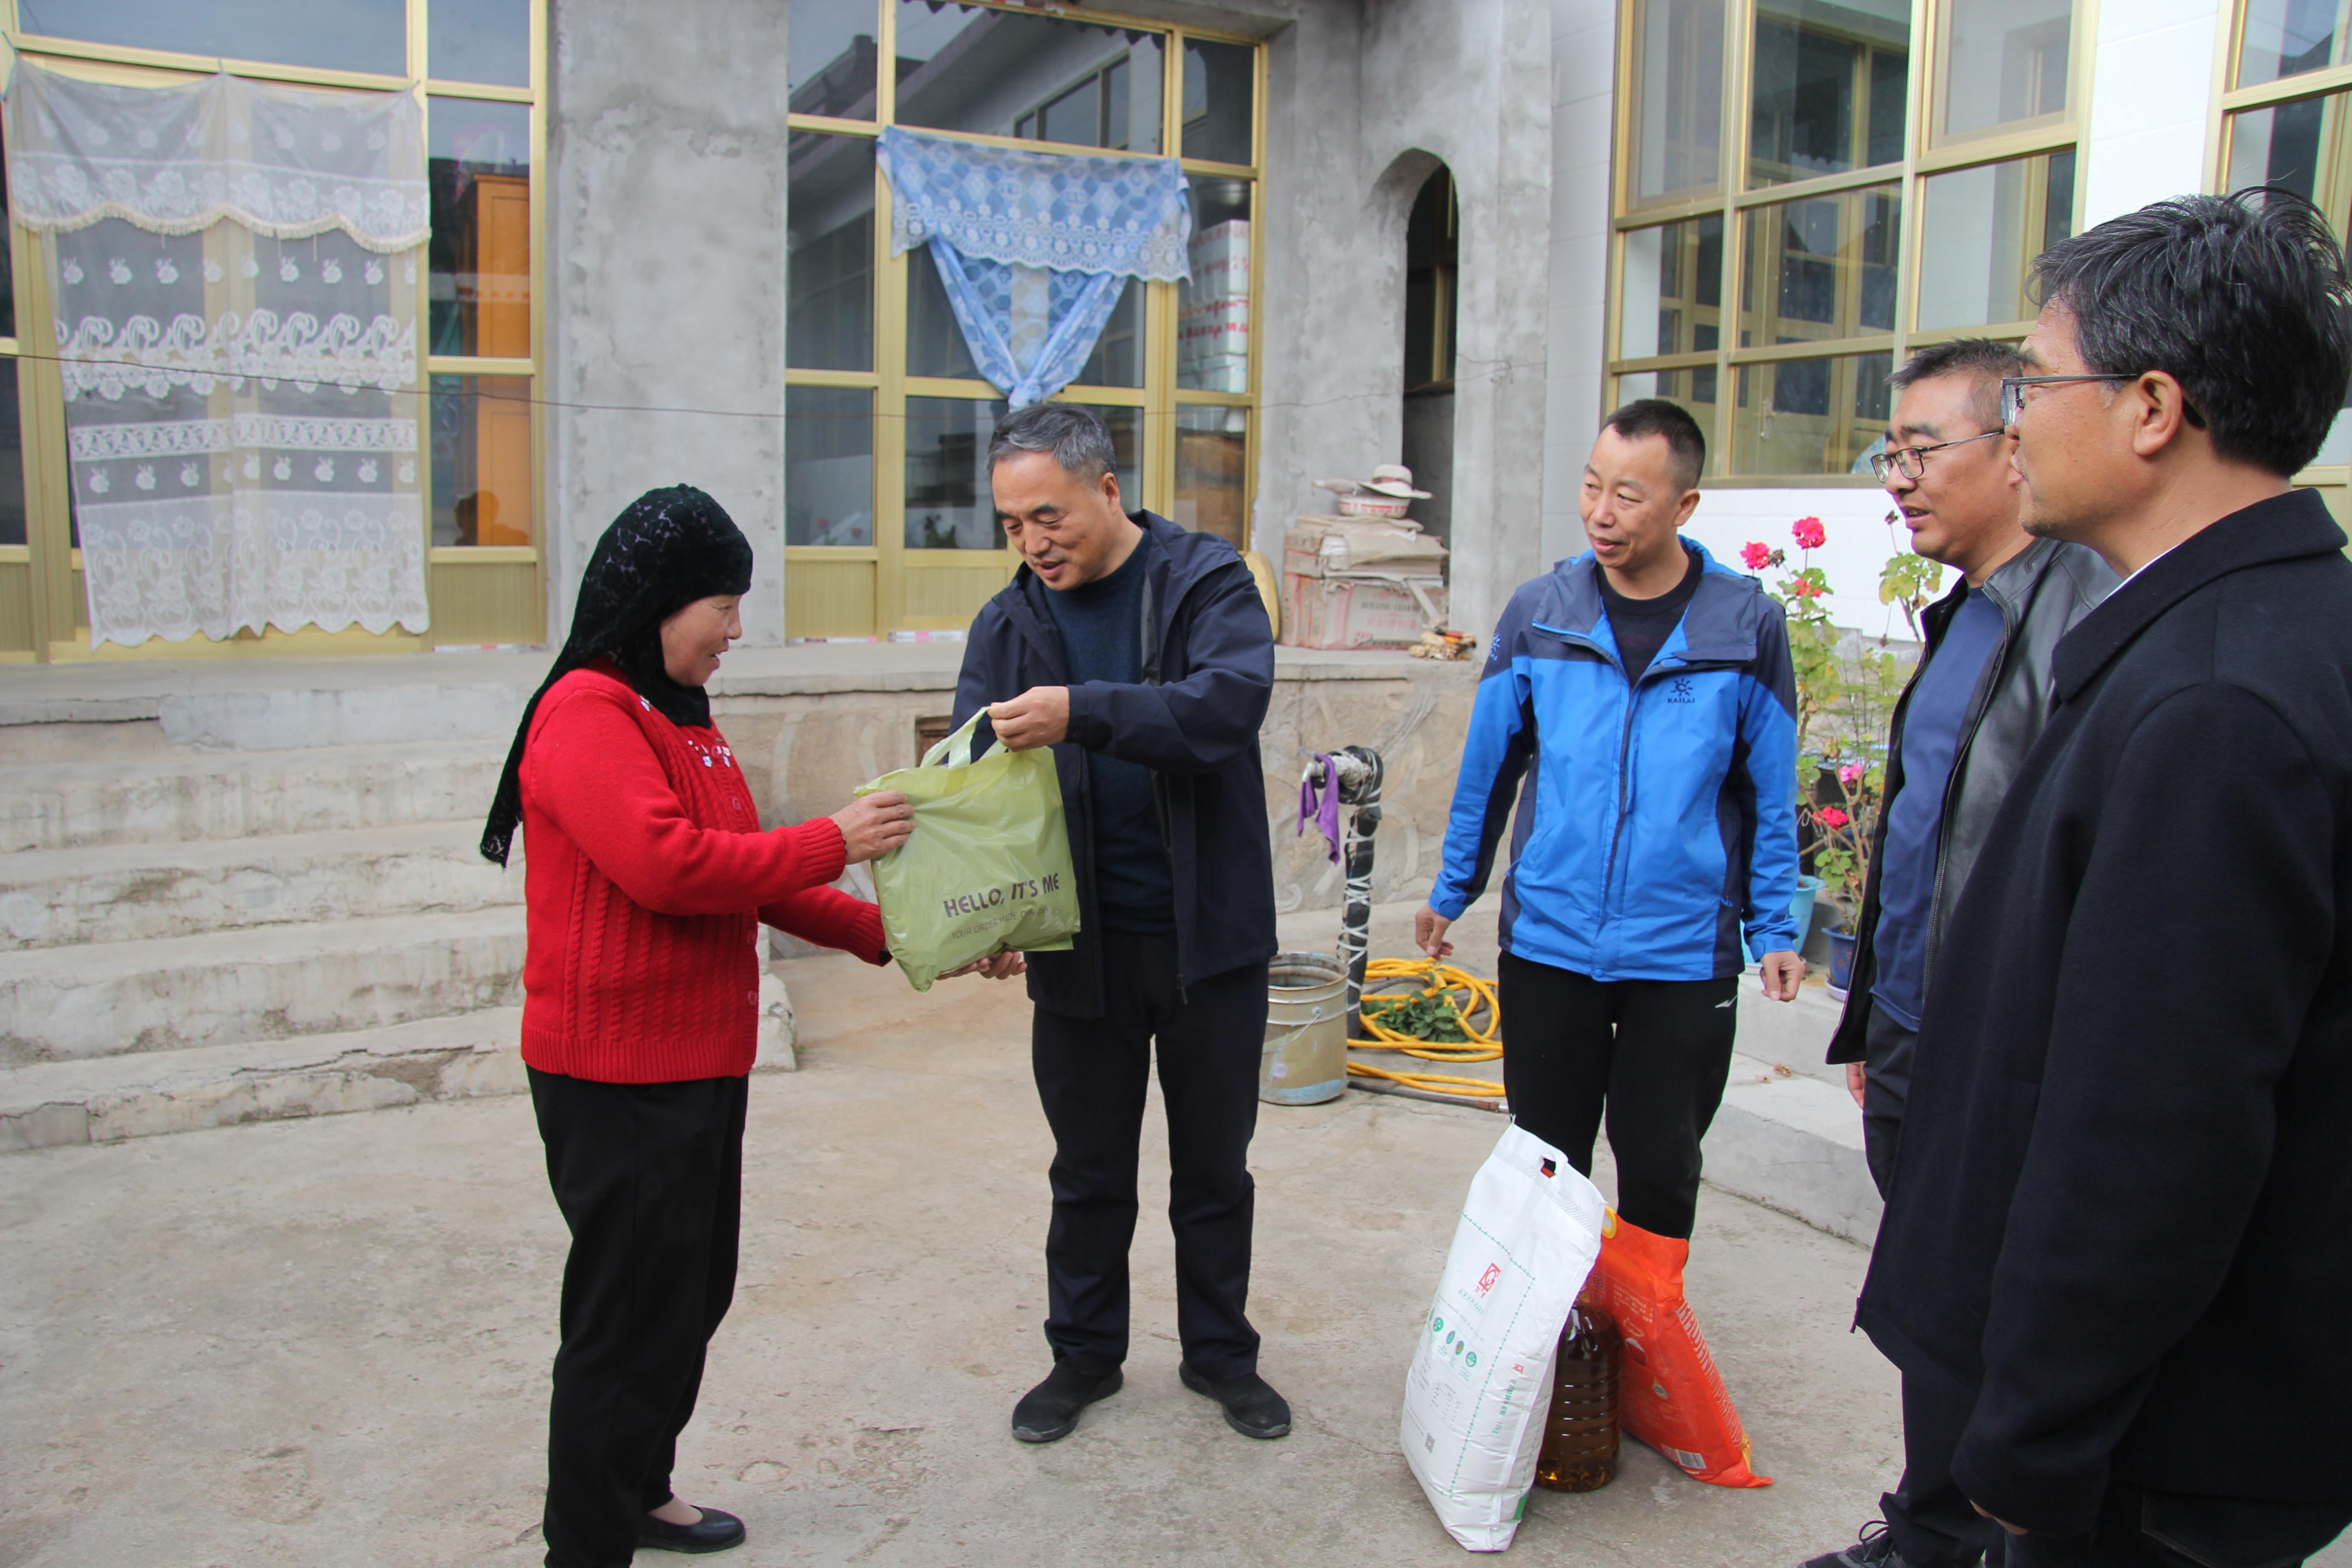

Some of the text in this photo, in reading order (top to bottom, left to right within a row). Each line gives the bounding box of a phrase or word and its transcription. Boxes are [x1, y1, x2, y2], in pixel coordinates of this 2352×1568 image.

[943, 873, 1059, 918] HELLO, IT'S ME
[951, 928, 972, 940] YOUR
[973, 919, 998, 934] ORDER
